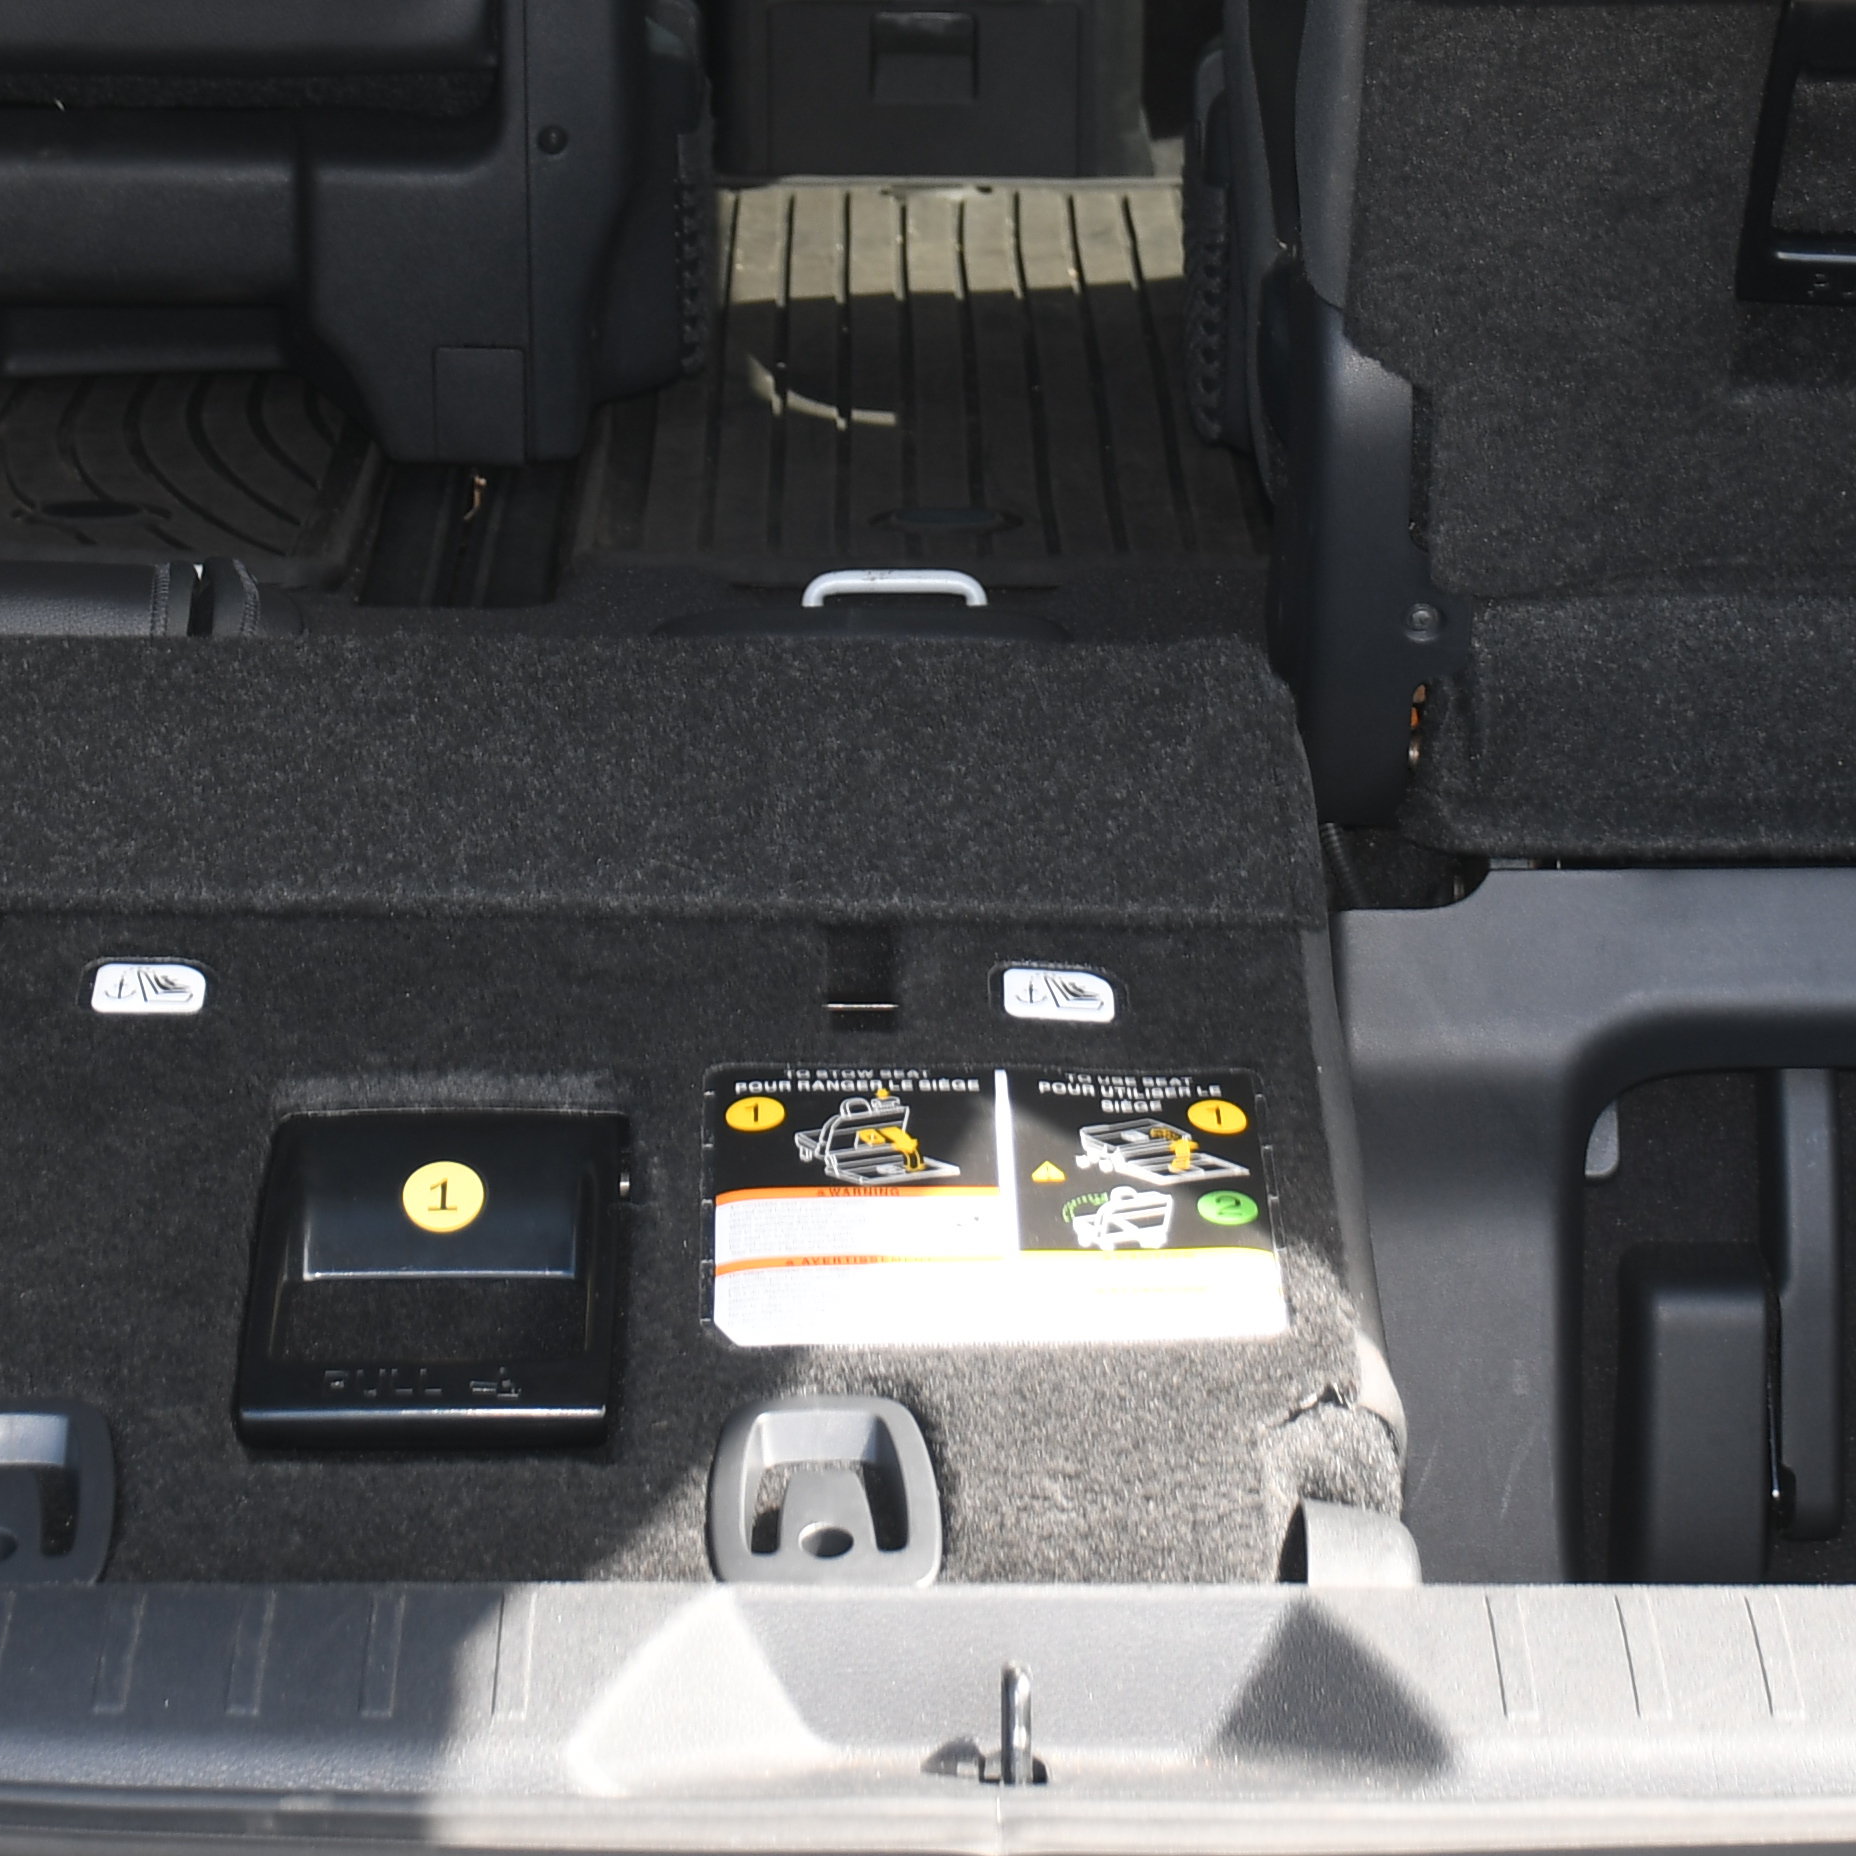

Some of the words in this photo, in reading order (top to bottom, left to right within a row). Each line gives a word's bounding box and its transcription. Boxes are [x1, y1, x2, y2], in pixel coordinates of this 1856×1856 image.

[785, 1068, 808, 1079] TO
[817, 1069, 873, 1079] STOW
[881, 1069, 929, 1079] SEAT
[1066, 1073, 1091, 1084] TO
[1142, 1076, 1192, 1087] SEAT
[734, 1080, 792, 1094] POUR
[798, 1079, 885, 1092] RANGER
[889, 1079, 913, 1092] LE
[1039, 1081, 1096, 1097] POUR
[1101, 1086, 1191, 1100] UTILISER
[1197, 1085, 1222, 1098] LE
[829, 1187, 900, 1197] WARNING
